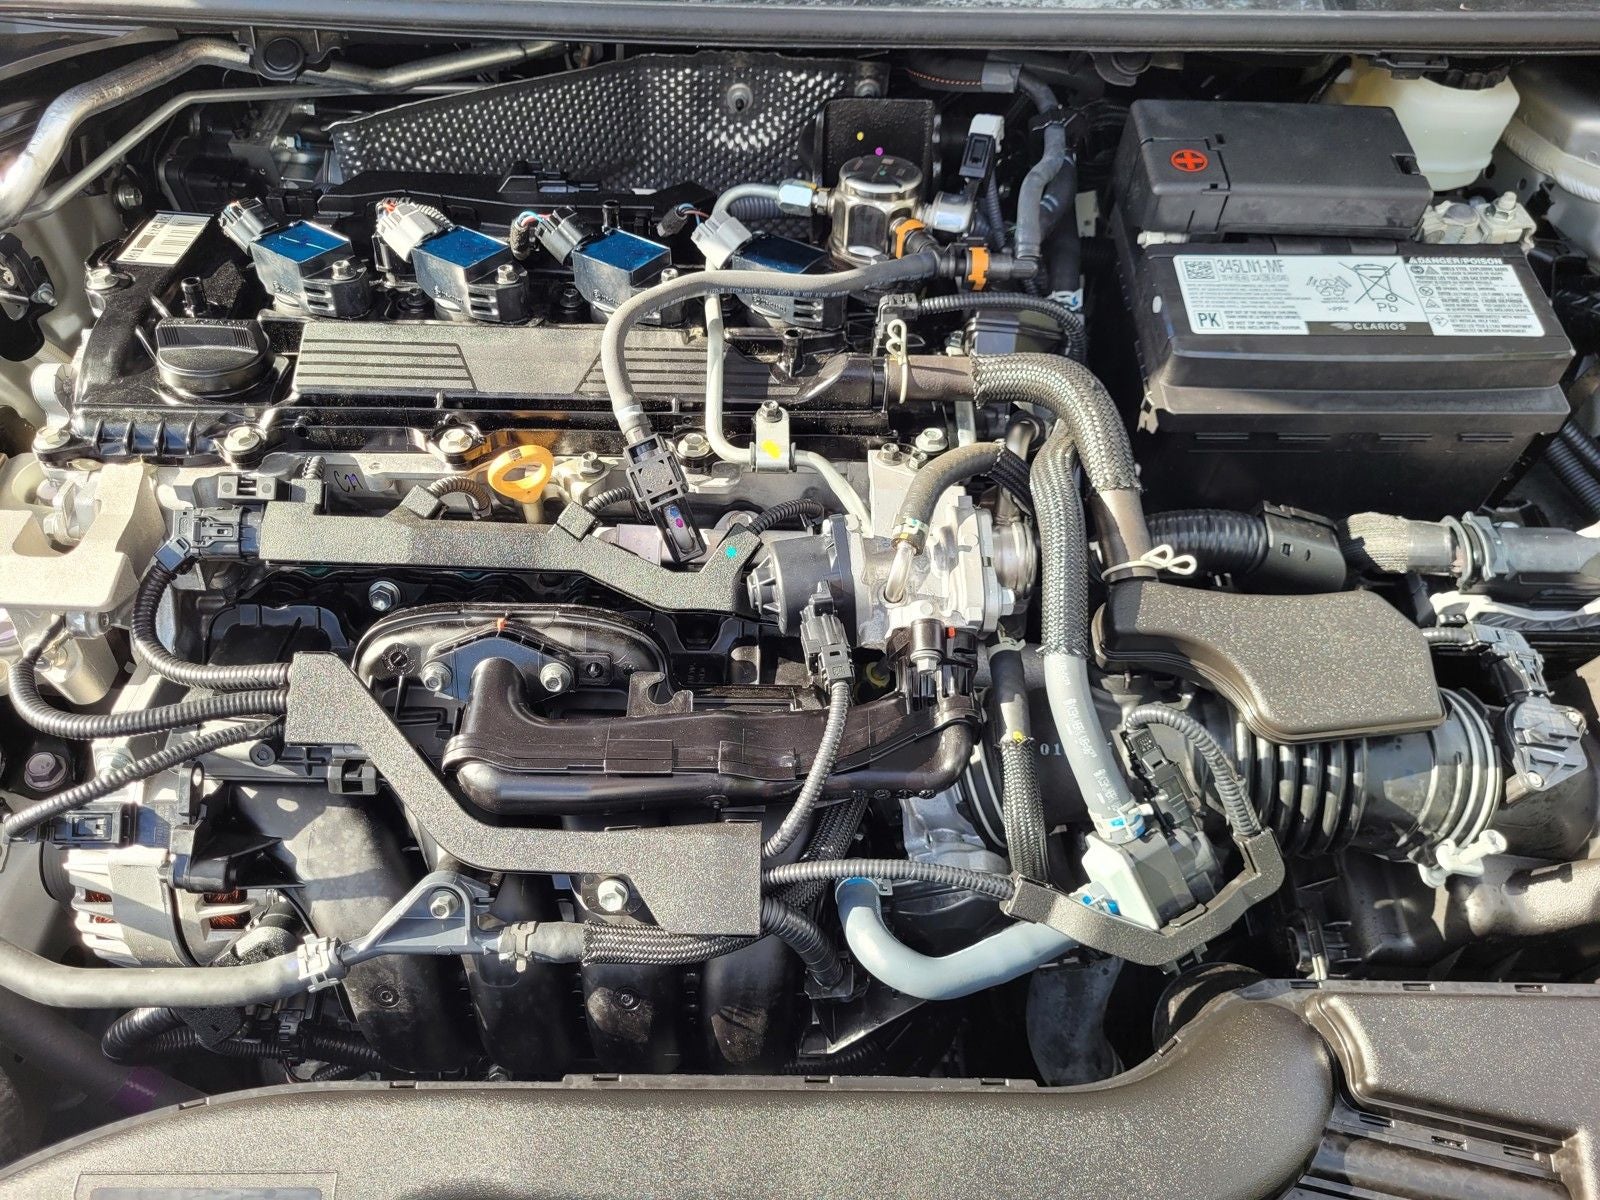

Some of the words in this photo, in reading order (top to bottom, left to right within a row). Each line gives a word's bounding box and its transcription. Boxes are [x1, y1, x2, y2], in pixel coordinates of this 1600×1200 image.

[1216, 259, 1285, 273] 345LN1-MF
[1416, 256, 1503, 265] DANGER/POISON
[1376, 302, 1399, 313] Pb
[1197, 312, 1221, 327] PK
[1353, 322, 1407, 331] CLARIOS
